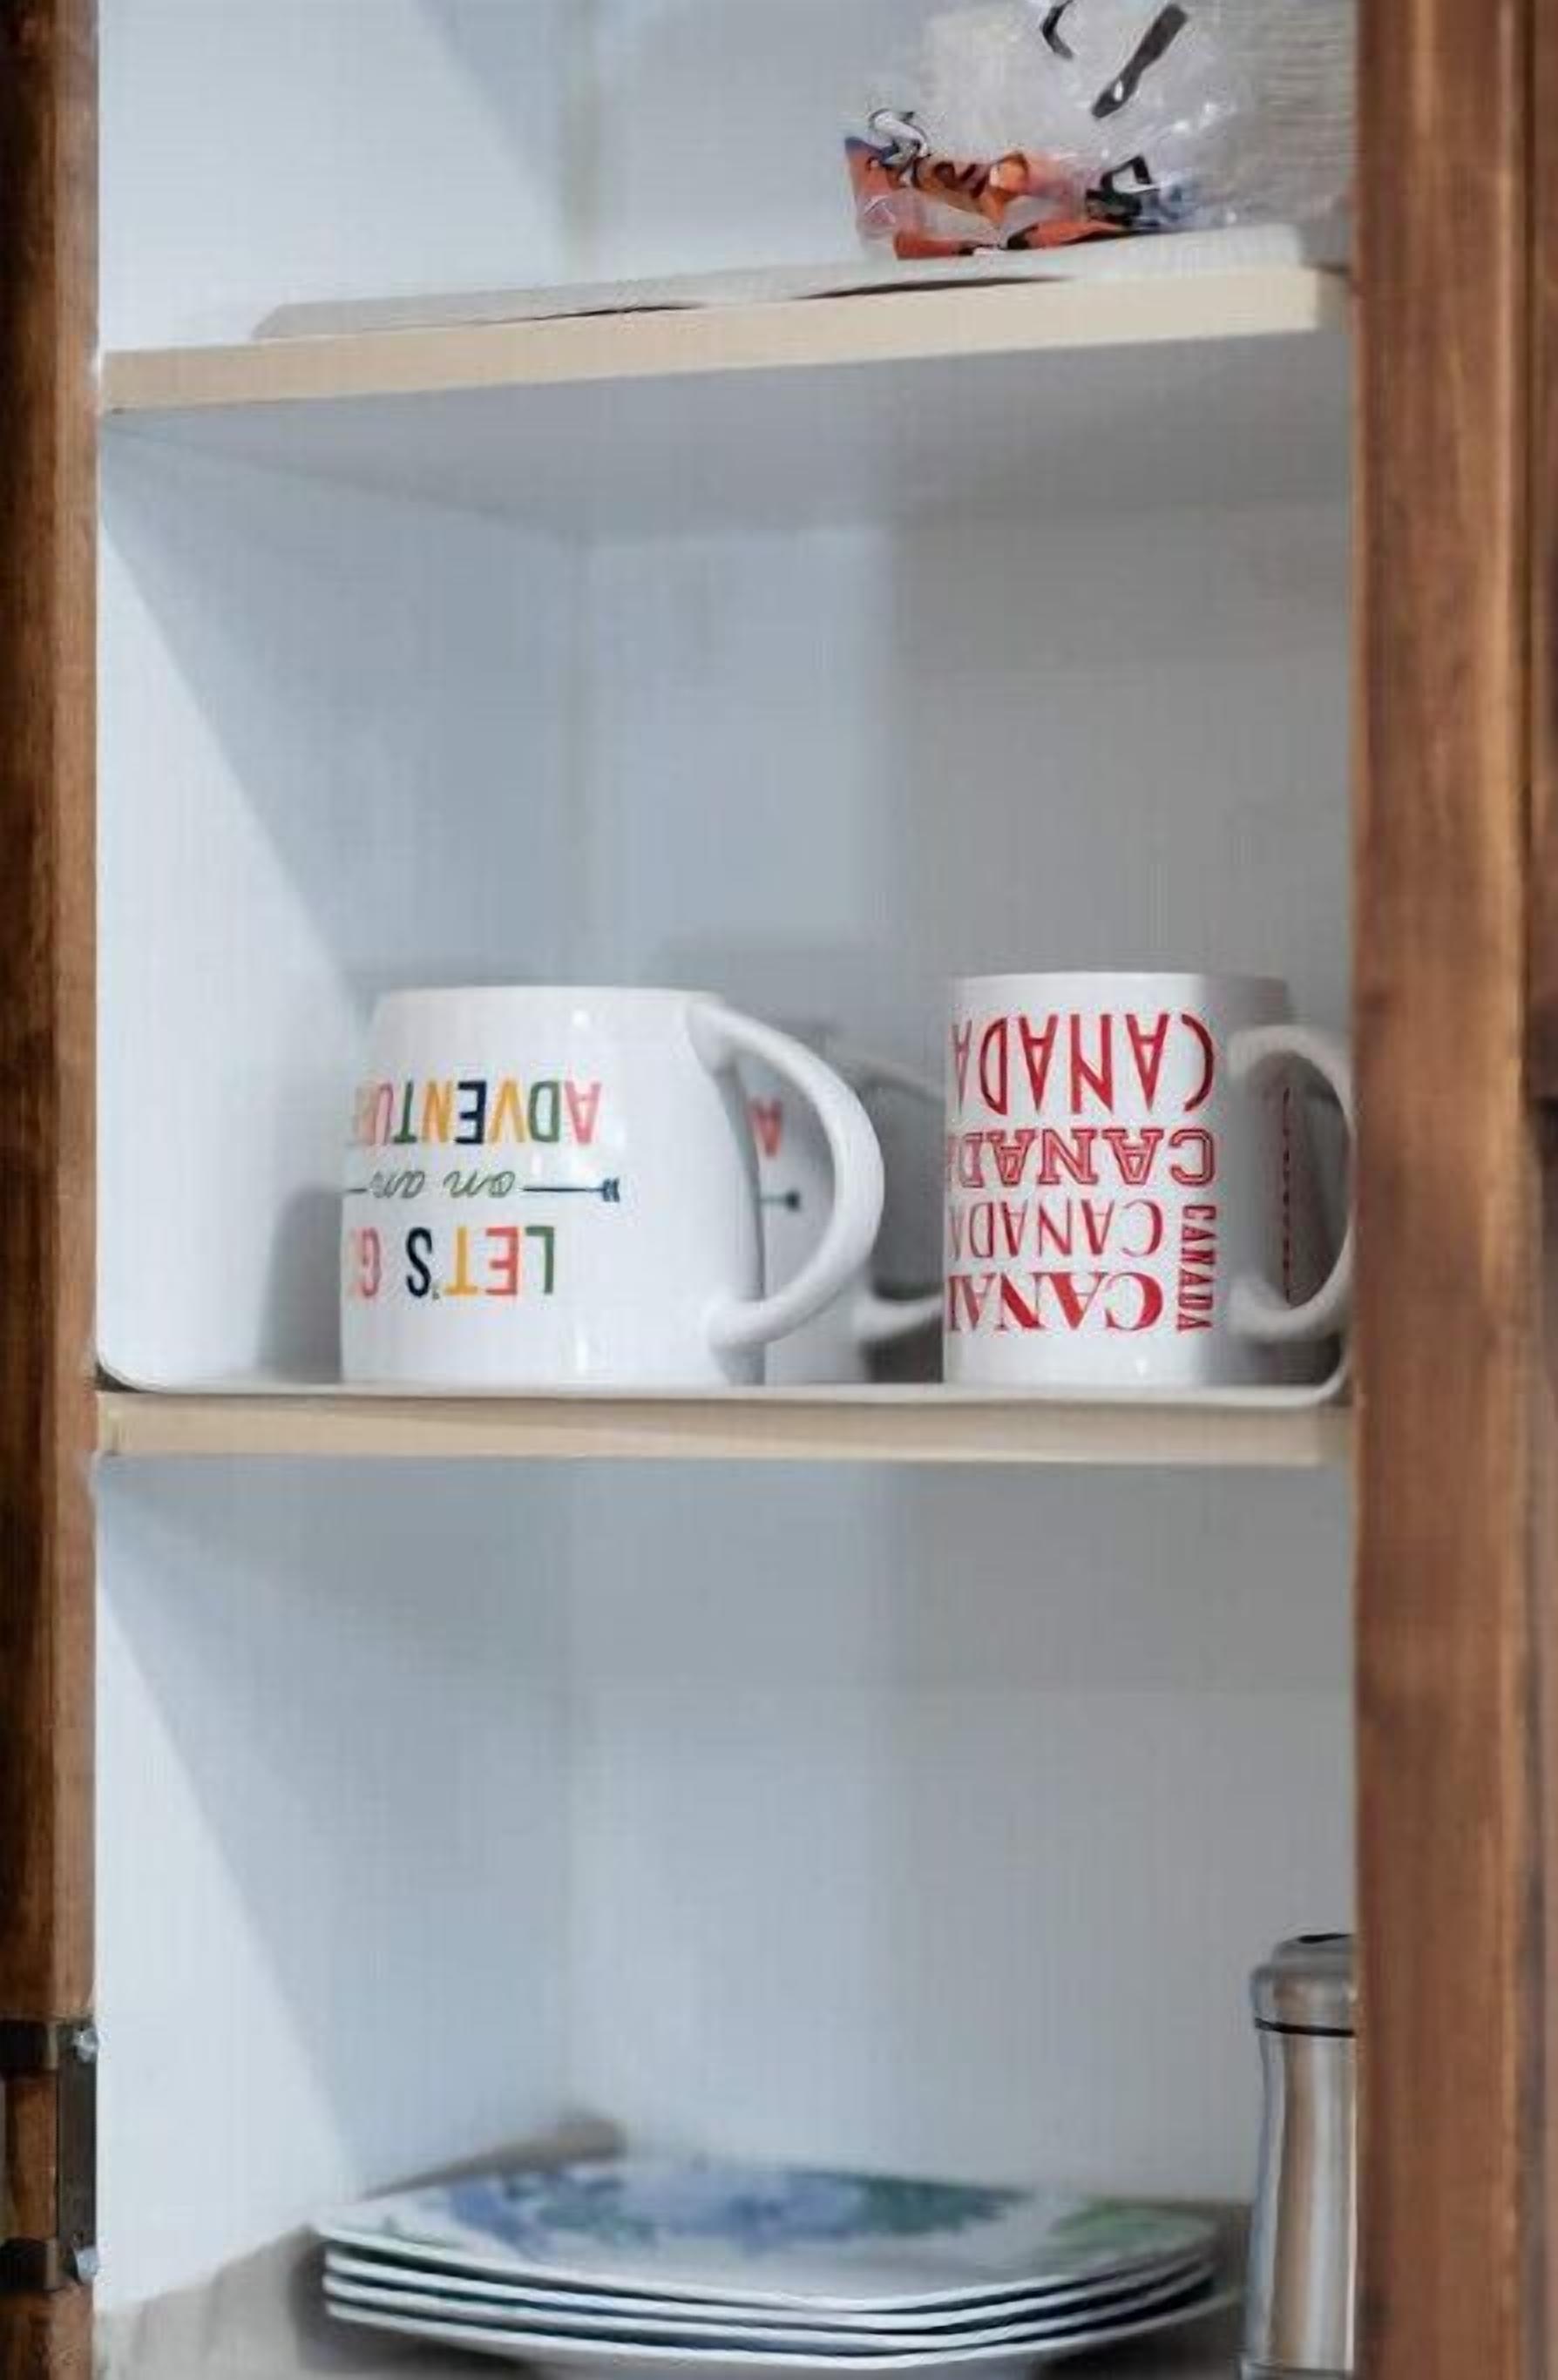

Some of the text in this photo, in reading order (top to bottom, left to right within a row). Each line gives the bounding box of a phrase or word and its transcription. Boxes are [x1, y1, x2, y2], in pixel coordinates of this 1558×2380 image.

[951, 1012, 1216, 1115] CANADA
[369, 1171, 517, 1200] on an
[404, 1225, 556, 1301] LET'S
[1176, 1204, 1217, 1332] CANADA
